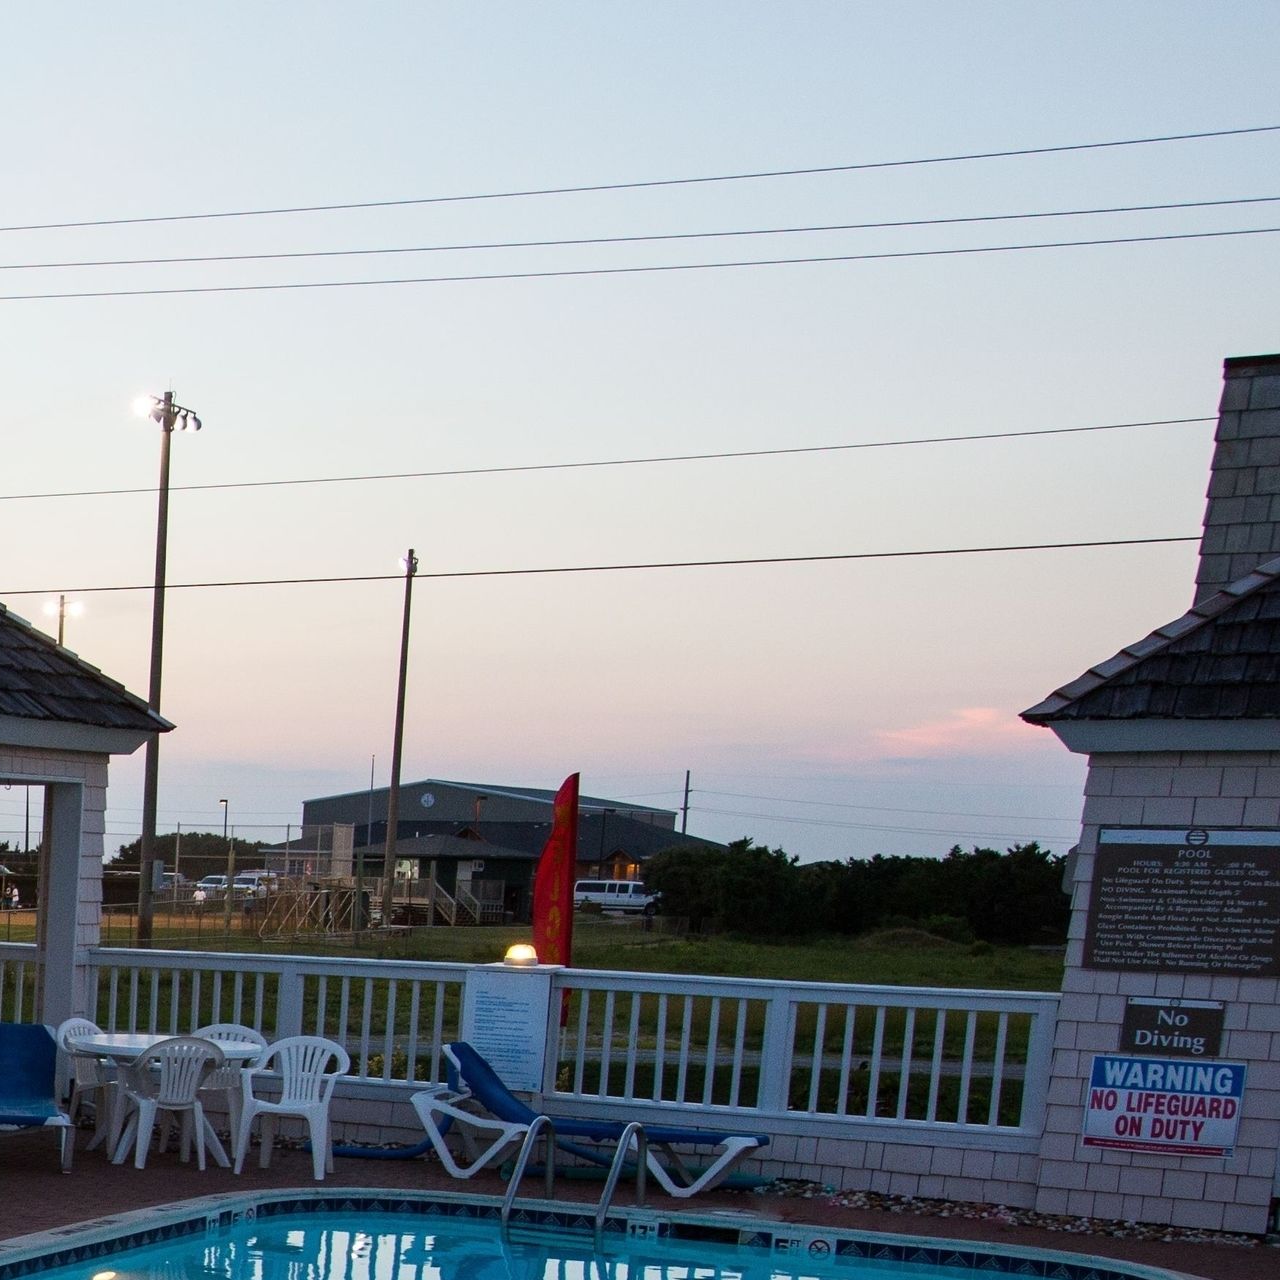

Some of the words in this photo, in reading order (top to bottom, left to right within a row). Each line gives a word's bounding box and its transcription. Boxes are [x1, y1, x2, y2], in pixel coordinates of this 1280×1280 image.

[1178, 849, 1212, 859] POOL
[1157, 1010, 1189, 1027] No
[1135, 1029, 1206, 1054] Diving
[1104, 1060, 1234, 1094] WARNING
[1090, 1089, 1118, 1111] NO
[1126, 1091, 1237, 1120] LIFEGUARD
[1114, 1115, 1142, 1137] ON
[1150, 1117, 1205, 1141] DUTY
